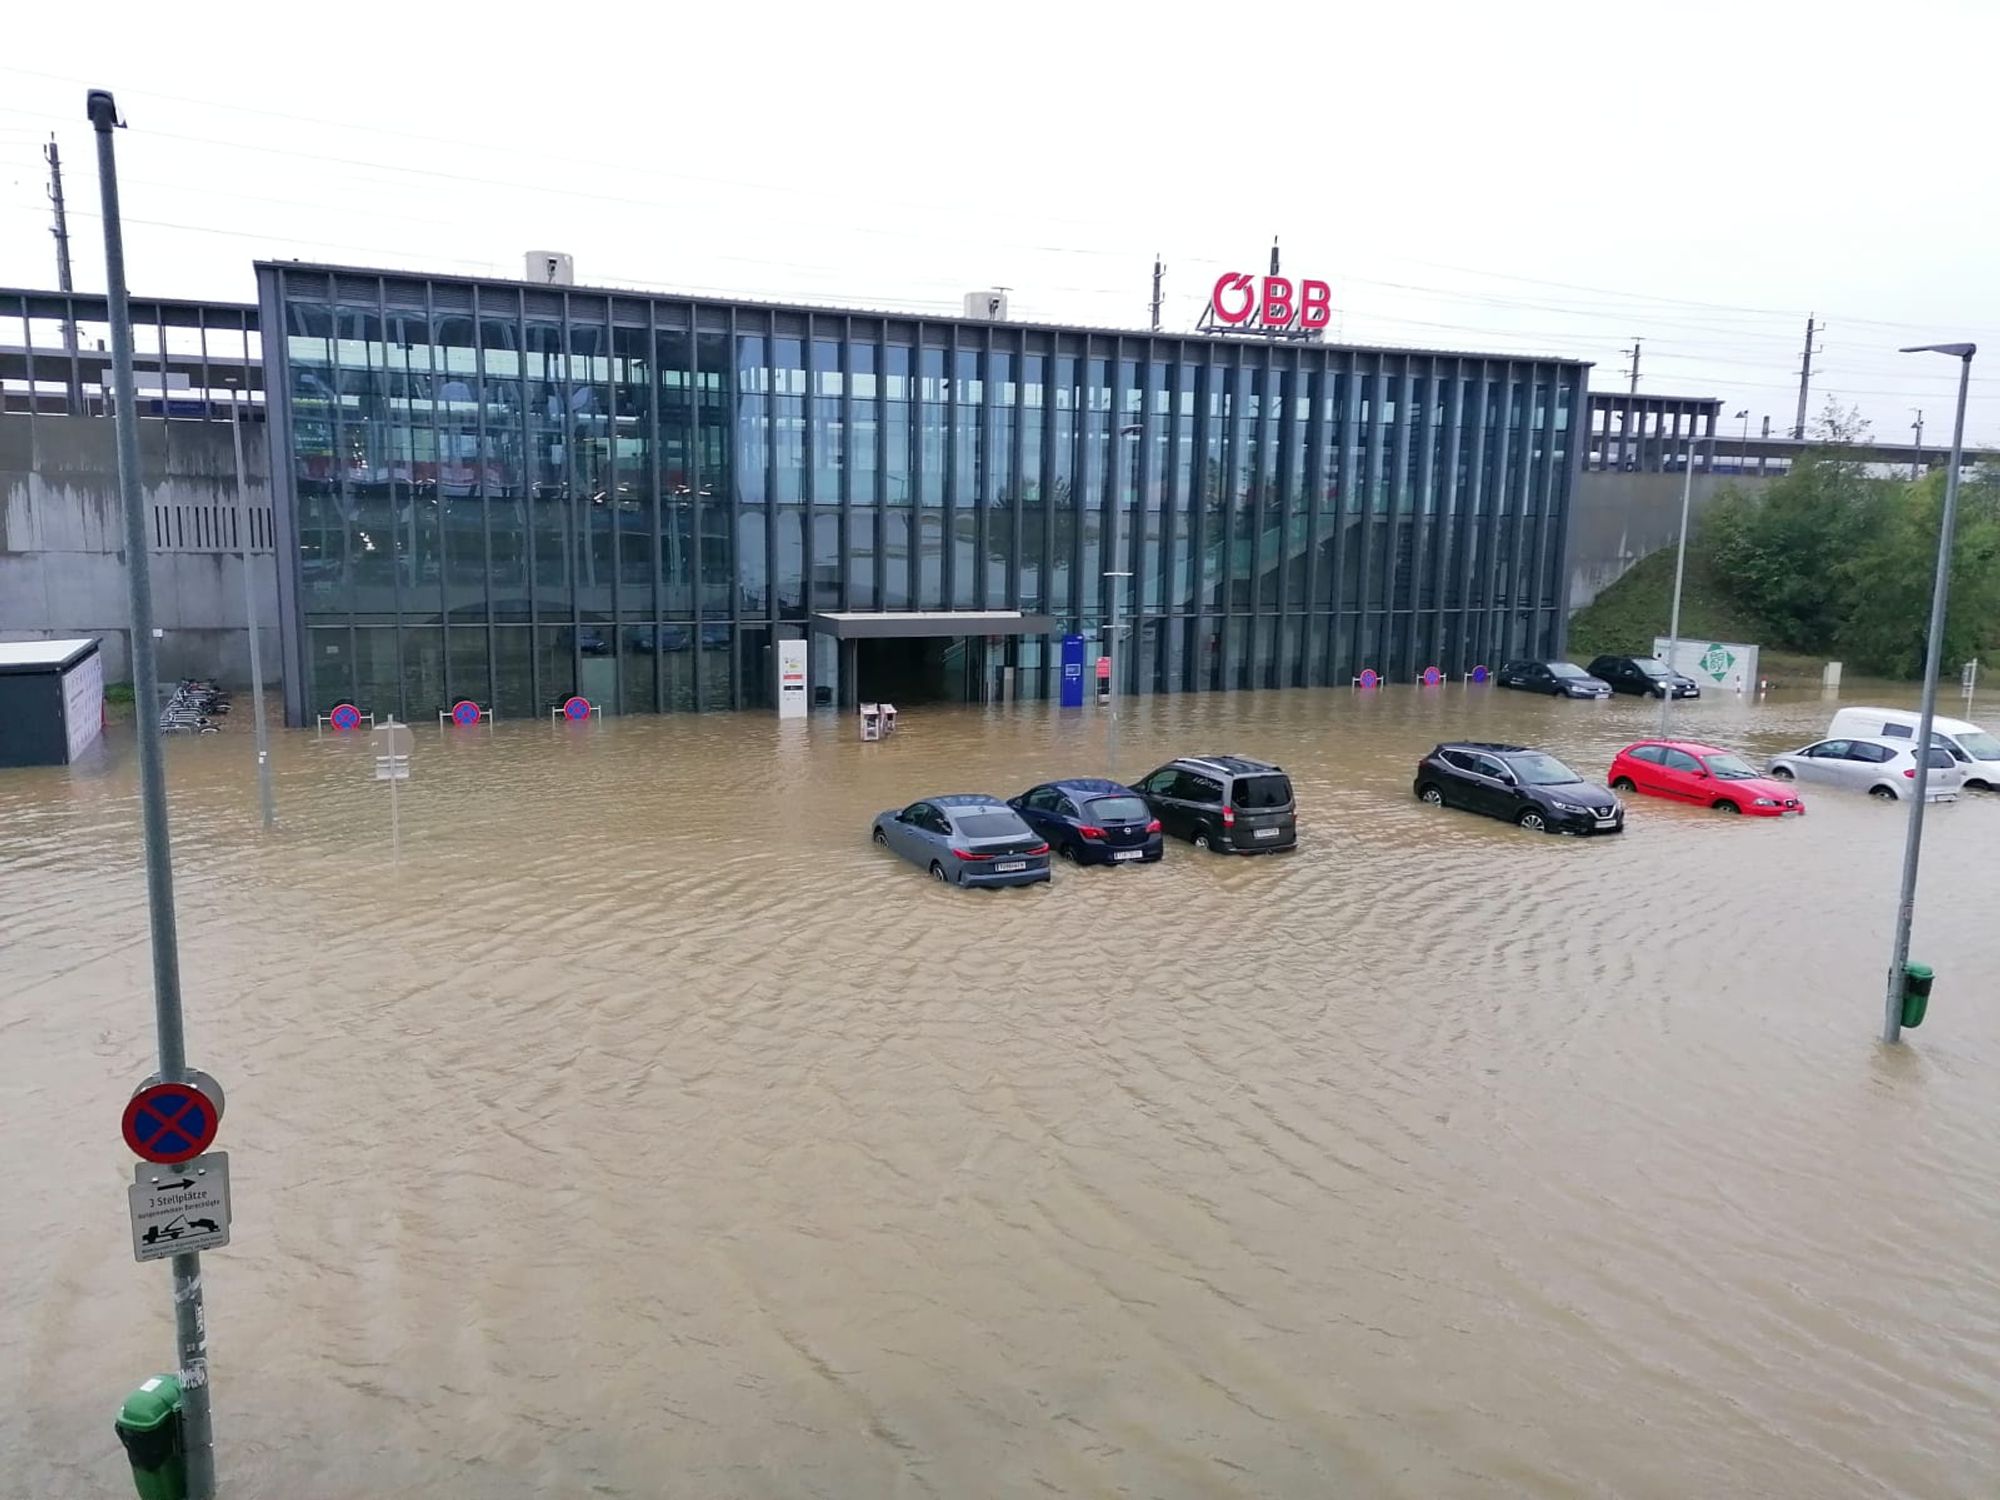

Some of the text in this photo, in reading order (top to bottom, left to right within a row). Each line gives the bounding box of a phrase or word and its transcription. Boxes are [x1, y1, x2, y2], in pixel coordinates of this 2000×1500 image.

[1212, 272, 1331, 328] ÖBB
[149, 1190, 208, 1208] 3 Stellplätze
